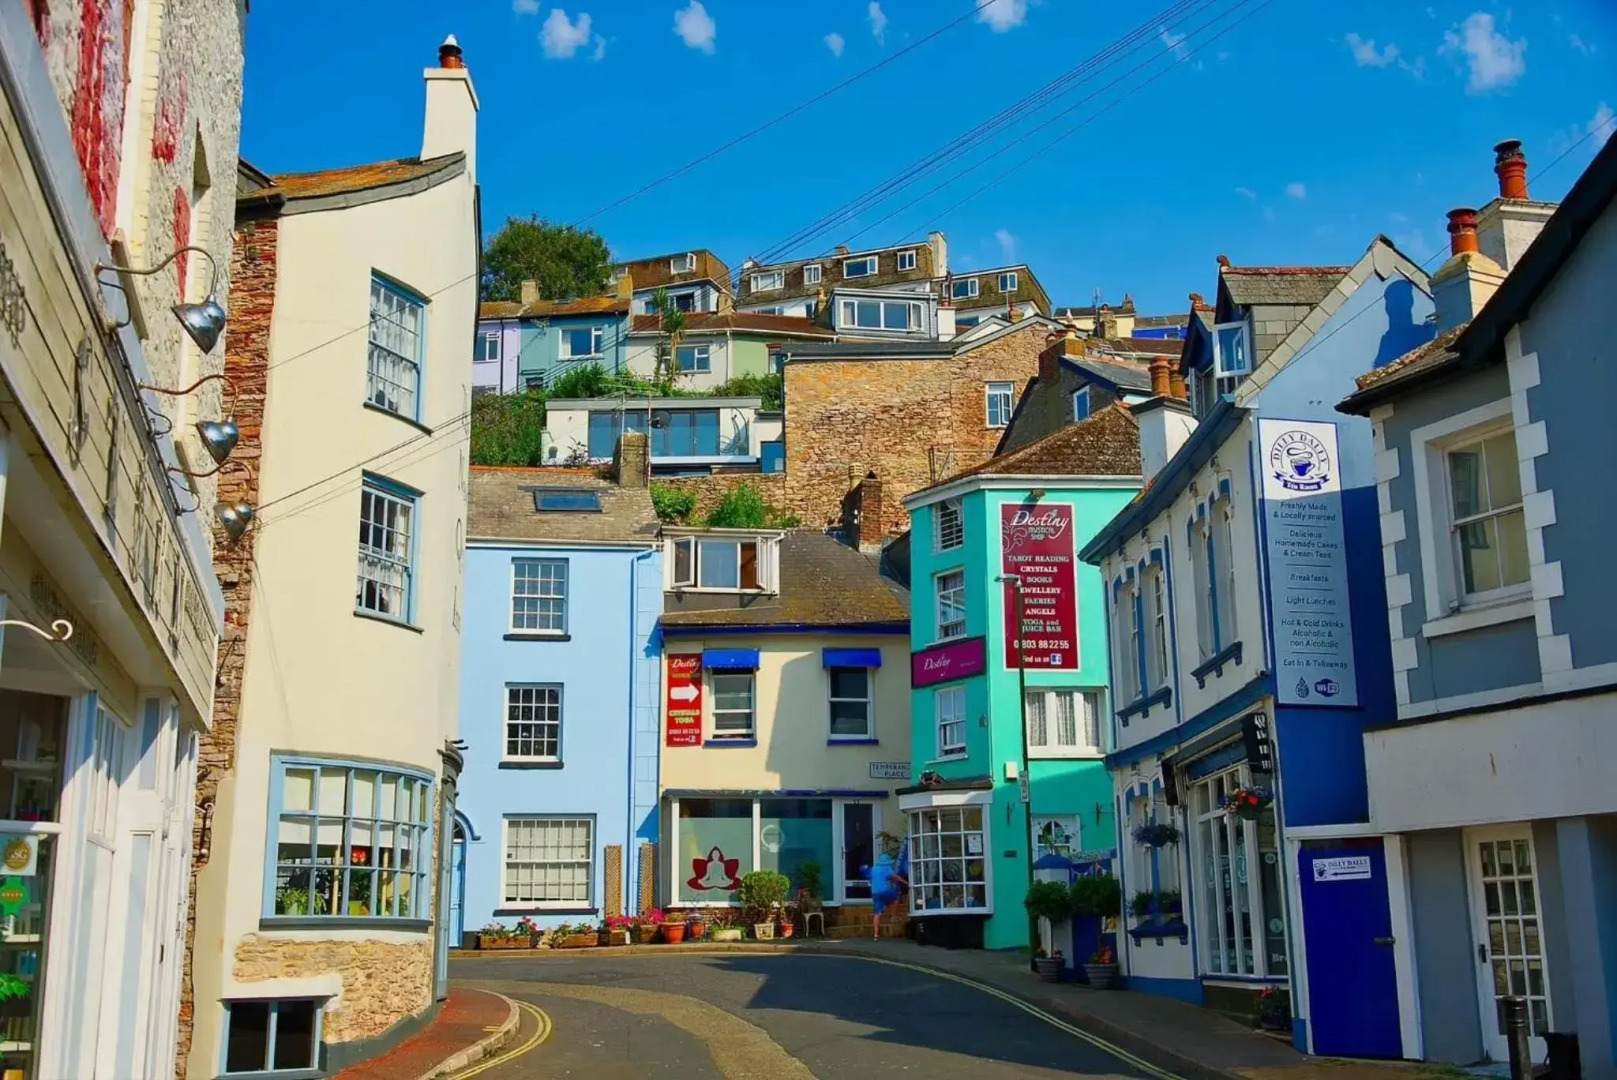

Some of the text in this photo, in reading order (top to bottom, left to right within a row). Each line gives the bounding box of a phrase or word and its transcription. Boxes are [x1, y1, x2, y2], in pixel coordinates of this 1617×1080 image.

[1273, 433, 1328, 464] DILLY DALLY
[1280, 502, 1306, 511] Freshly
[1280, 511, 1306, 521] Locally
[1010, 510, 1069, 539] Destiny
[1290, 530, 1322, 538] Delicious
[1275, 540, 1338, 549] Homemade Cakes
[1290, 574, 1329, 582] Breakfasts
[1286, 596, 1336, 606] Light Lunches
[1014, 640, 1036, 648] 0803
[1314, 660, 1347, 669] Takeaway
